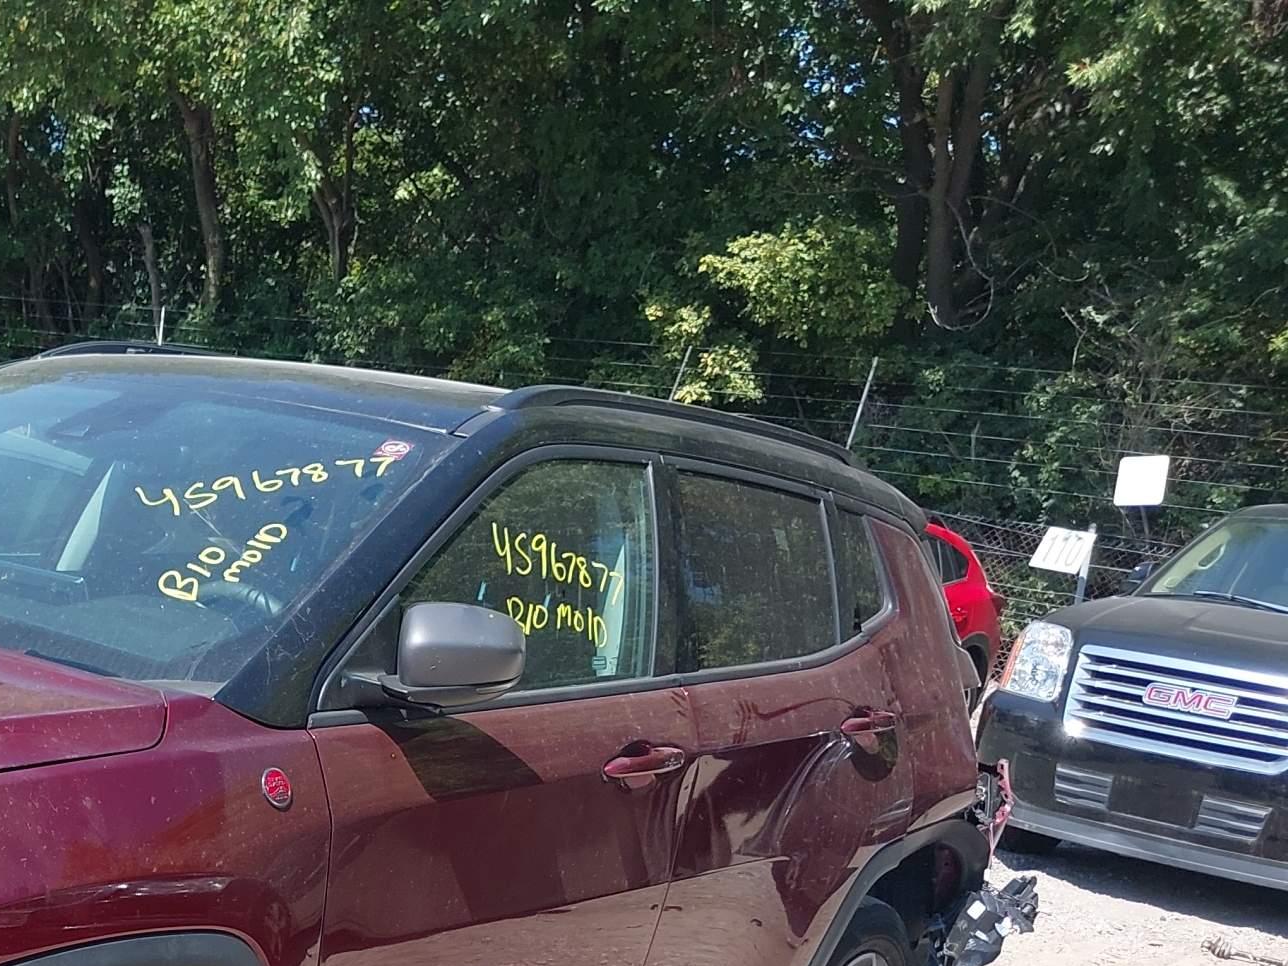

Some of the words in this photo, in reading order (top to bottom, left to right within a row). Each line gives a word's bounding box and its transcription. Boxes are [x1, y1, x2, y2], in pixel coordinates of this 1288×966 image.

[134, 455, 395, 516] 45967877
[491, 521, 625, 608] 45967877
[1143, 682, 1238, 720] GMC
